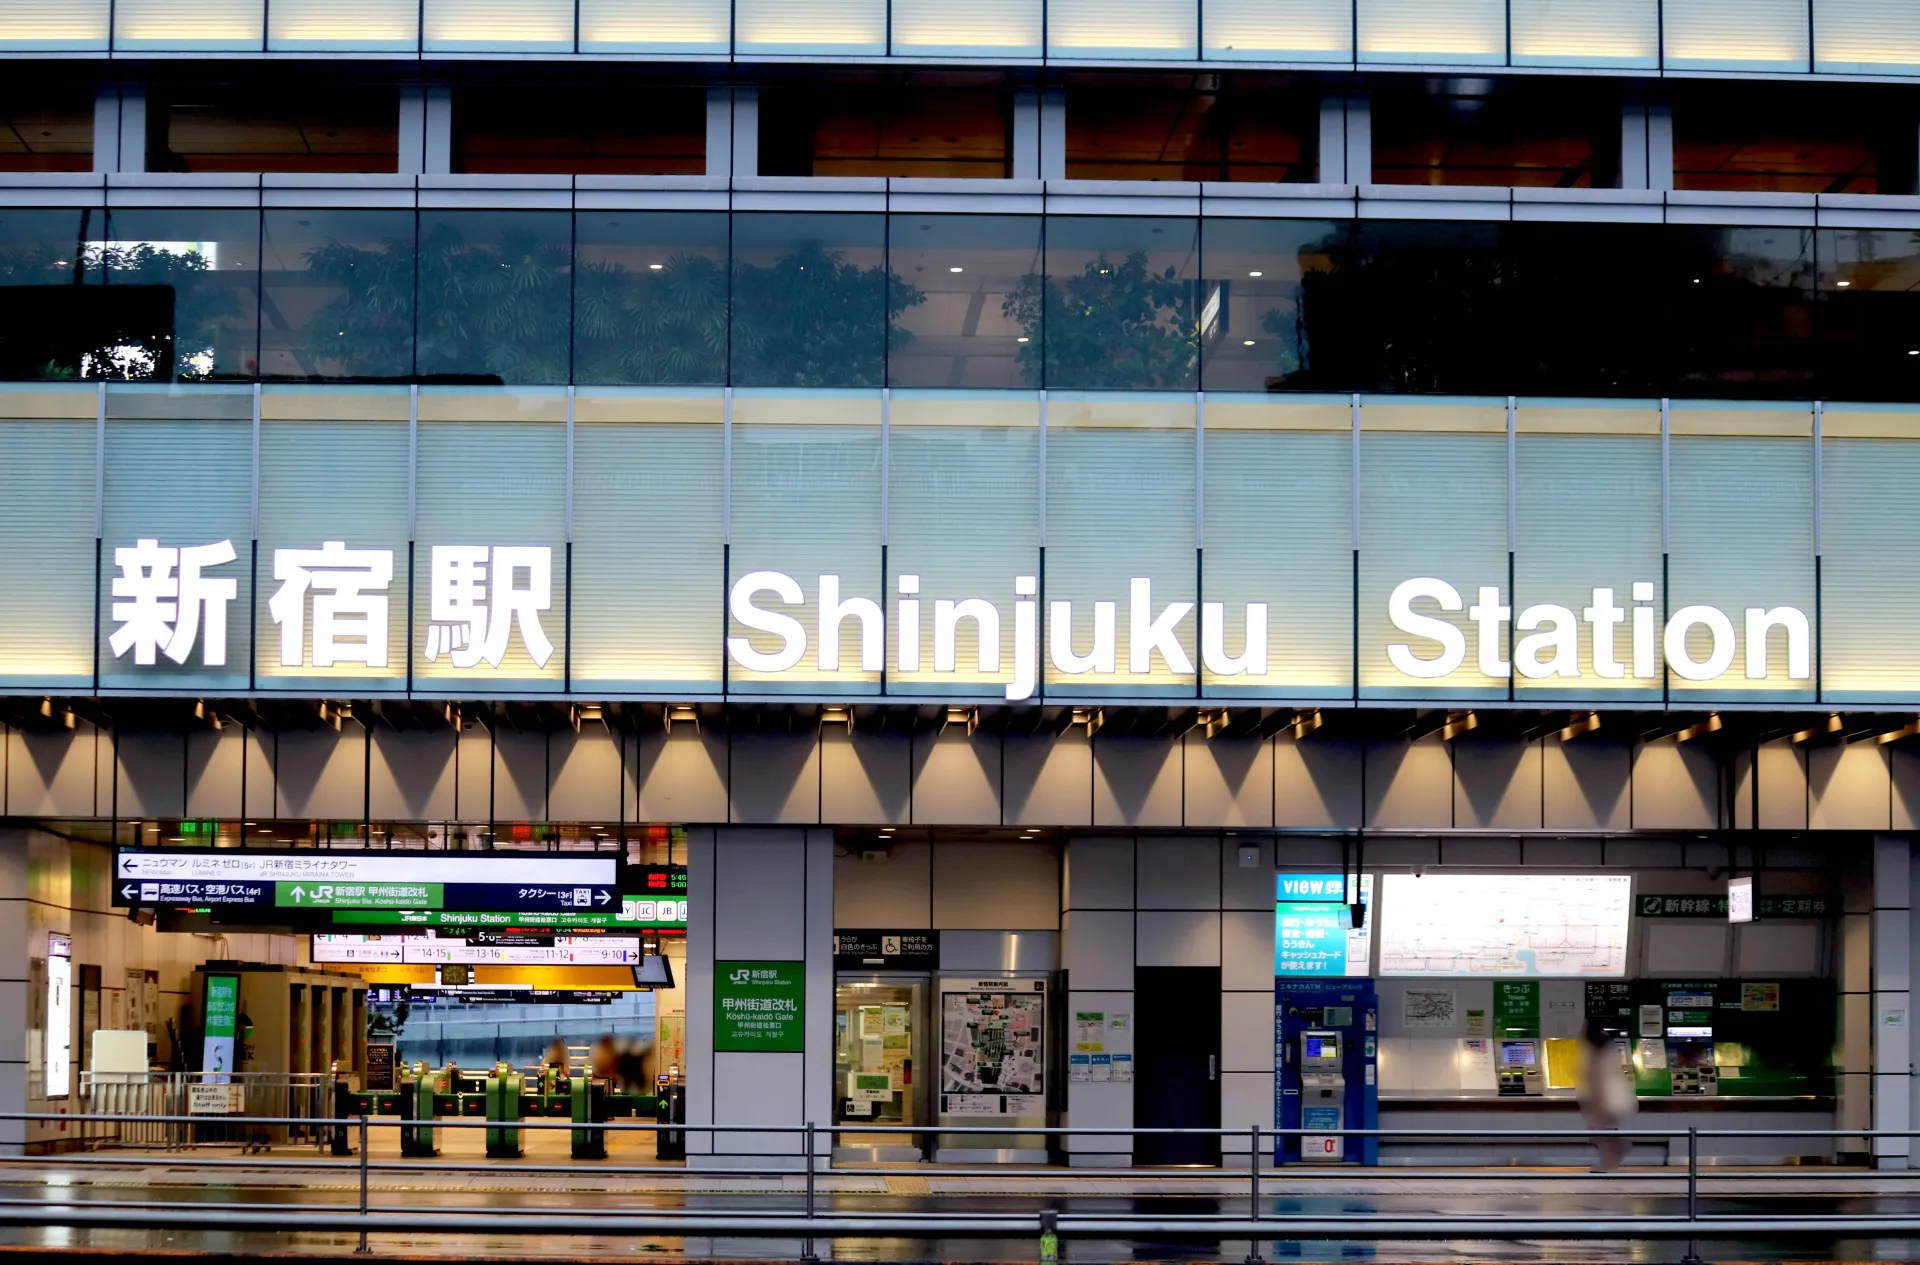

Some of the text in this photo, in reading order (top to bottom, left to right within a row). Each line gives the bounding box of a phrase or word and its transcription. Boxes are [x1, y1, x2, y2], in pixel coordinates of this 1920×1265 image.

[108, 539, 555, 669] 新宿駅
[727, 571, 1811, 700] Shinjuku Station
[141, 858, 188, 867] ニュウマン
[259, 859, 358, 870] JR新宿ミライナタワー
[309, 885, 334, 899] JR
[335, 886, 429, 898] 新宿駅 甲州街道改札
[518, 888, 557, 899] タクシー
[160, 895, 191, 903] Expressway
[204, 896, 221, 904] Airport
[220, 896, 243, 904] Express
[335, 897, 361, 905] Shinjuku
[641, 906, 652, 915] JC
[661, 907, 672, 915] JB
[440, 913, 478, 924] Shinjuku
[480, 913, 511, 924] Station
[901, 943, 934, 951] ご利用の方
[1281, 950, 1341, 959] キャッシュカード
[729, 969, 750, 981] JR
[751, 969, 778, 979] 新宿駅
[1503, 984, 1530, 993] きっぷ
[722, 998, 798, 1011] 甲州街道改札
[775, 1012, 794, 1021] Gate
